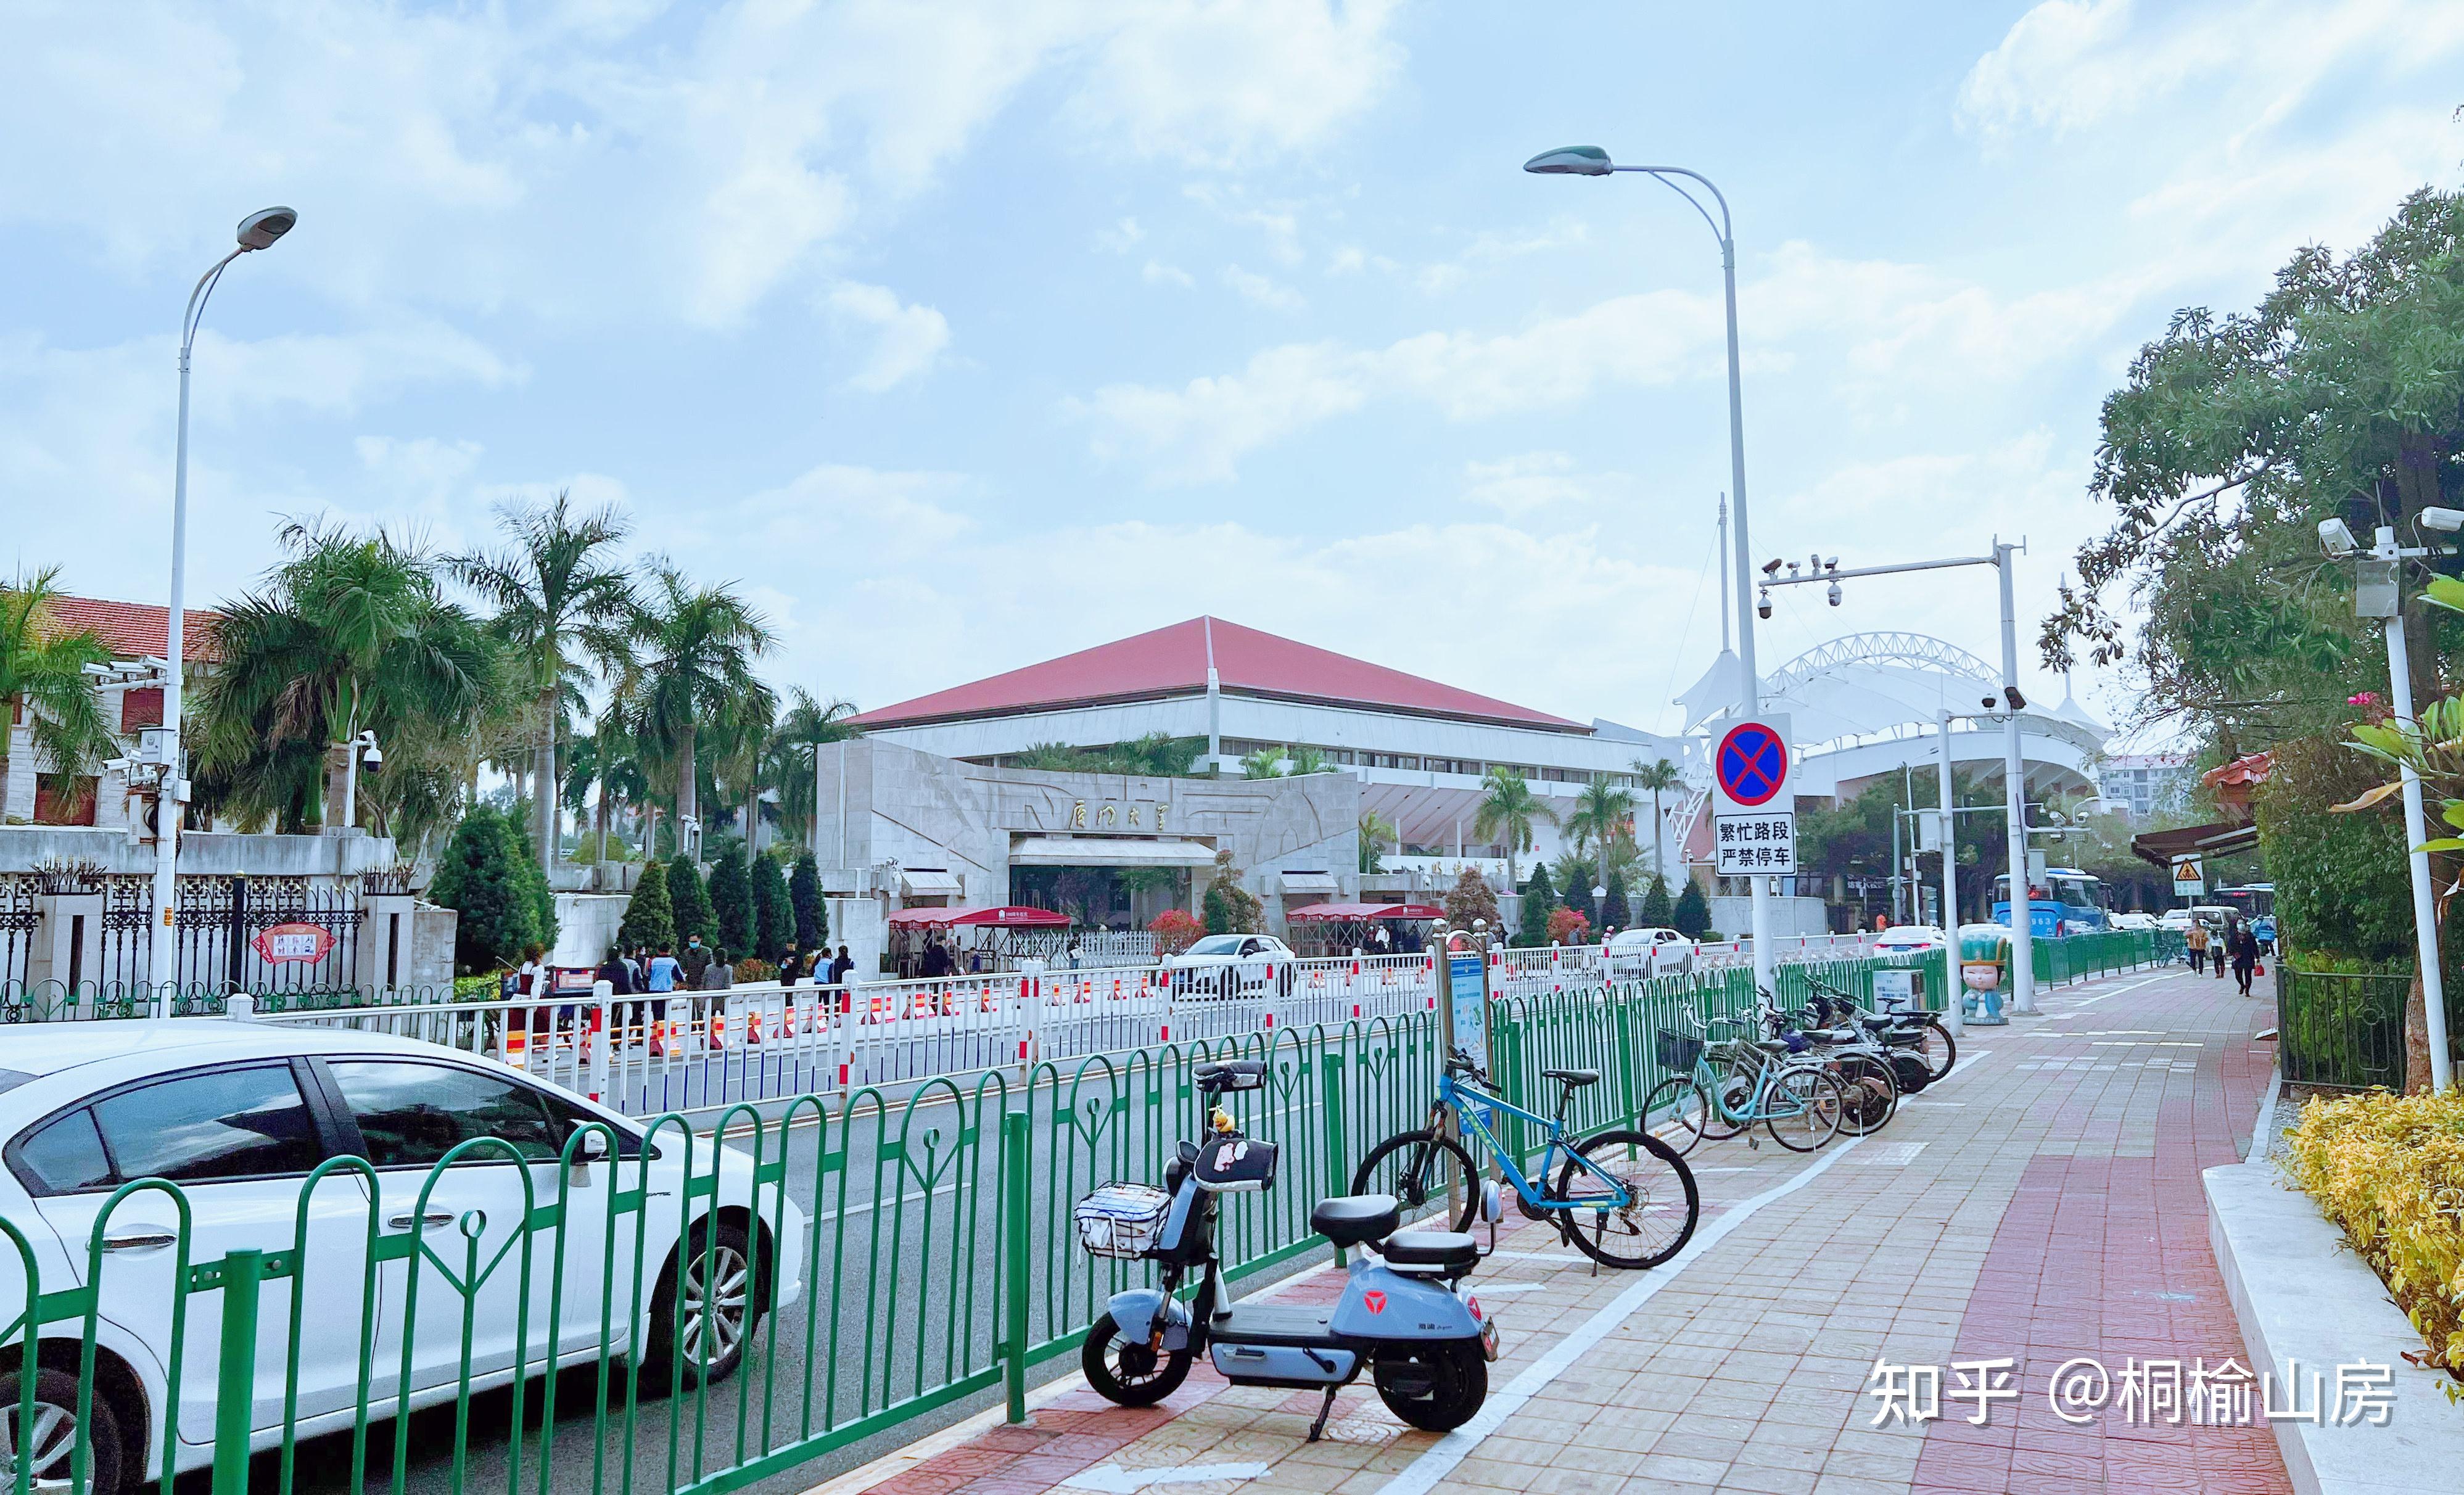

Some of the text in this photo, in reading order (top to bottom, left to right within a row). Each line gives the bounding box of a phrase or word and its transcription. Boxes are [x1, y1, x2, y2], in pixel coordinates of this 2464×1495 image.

[1068, 799, 1169, 830] 厦门大学
[1720, 822, 1789, 842] 繁忙路段
[1721, 847, 1790, 867] 严禁停车
